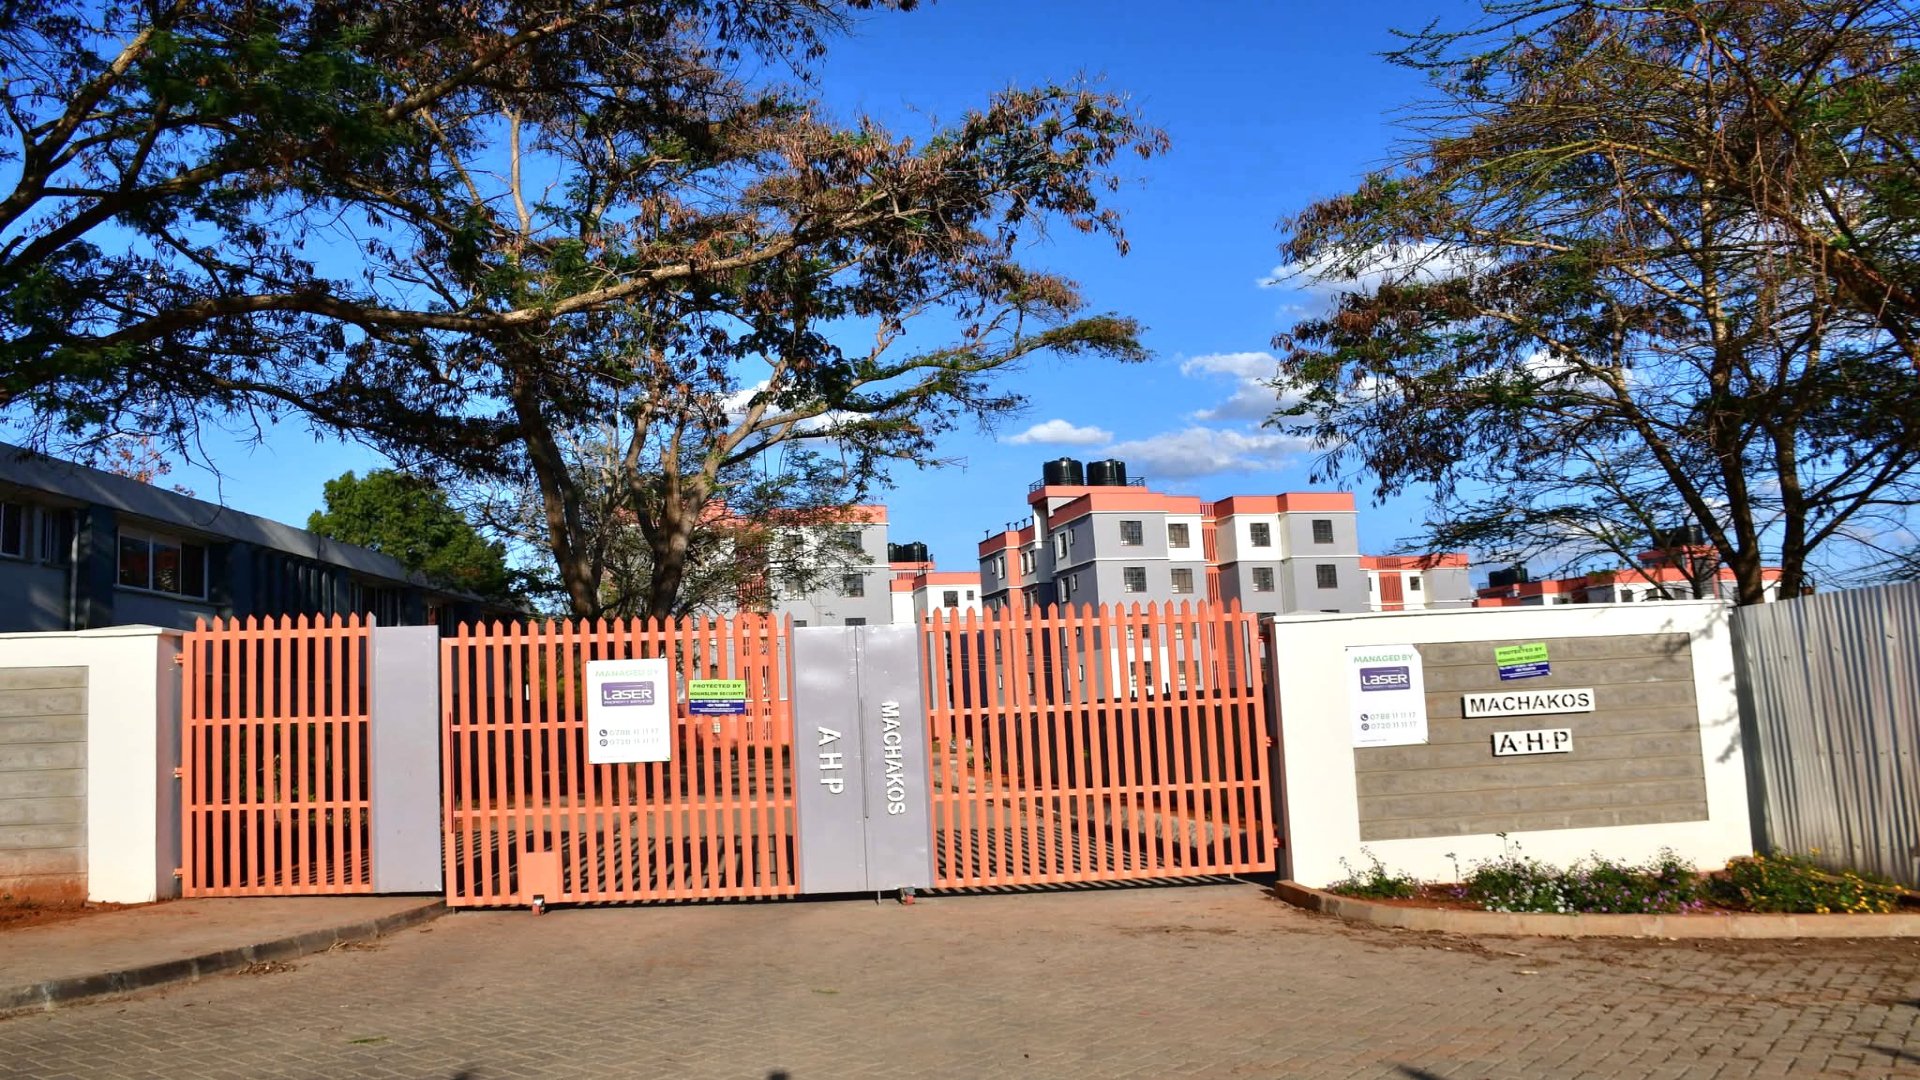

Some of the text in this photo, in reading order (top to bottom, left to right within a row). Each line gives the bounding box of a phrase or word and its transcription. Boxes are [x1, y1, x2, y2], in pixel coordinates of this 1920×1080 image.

[1354, 655, 1401, 663] MANAGED
[1470, 693, 1590, 712] MACHAKOS
[881, 700, 906, 815] MACHAKOS
